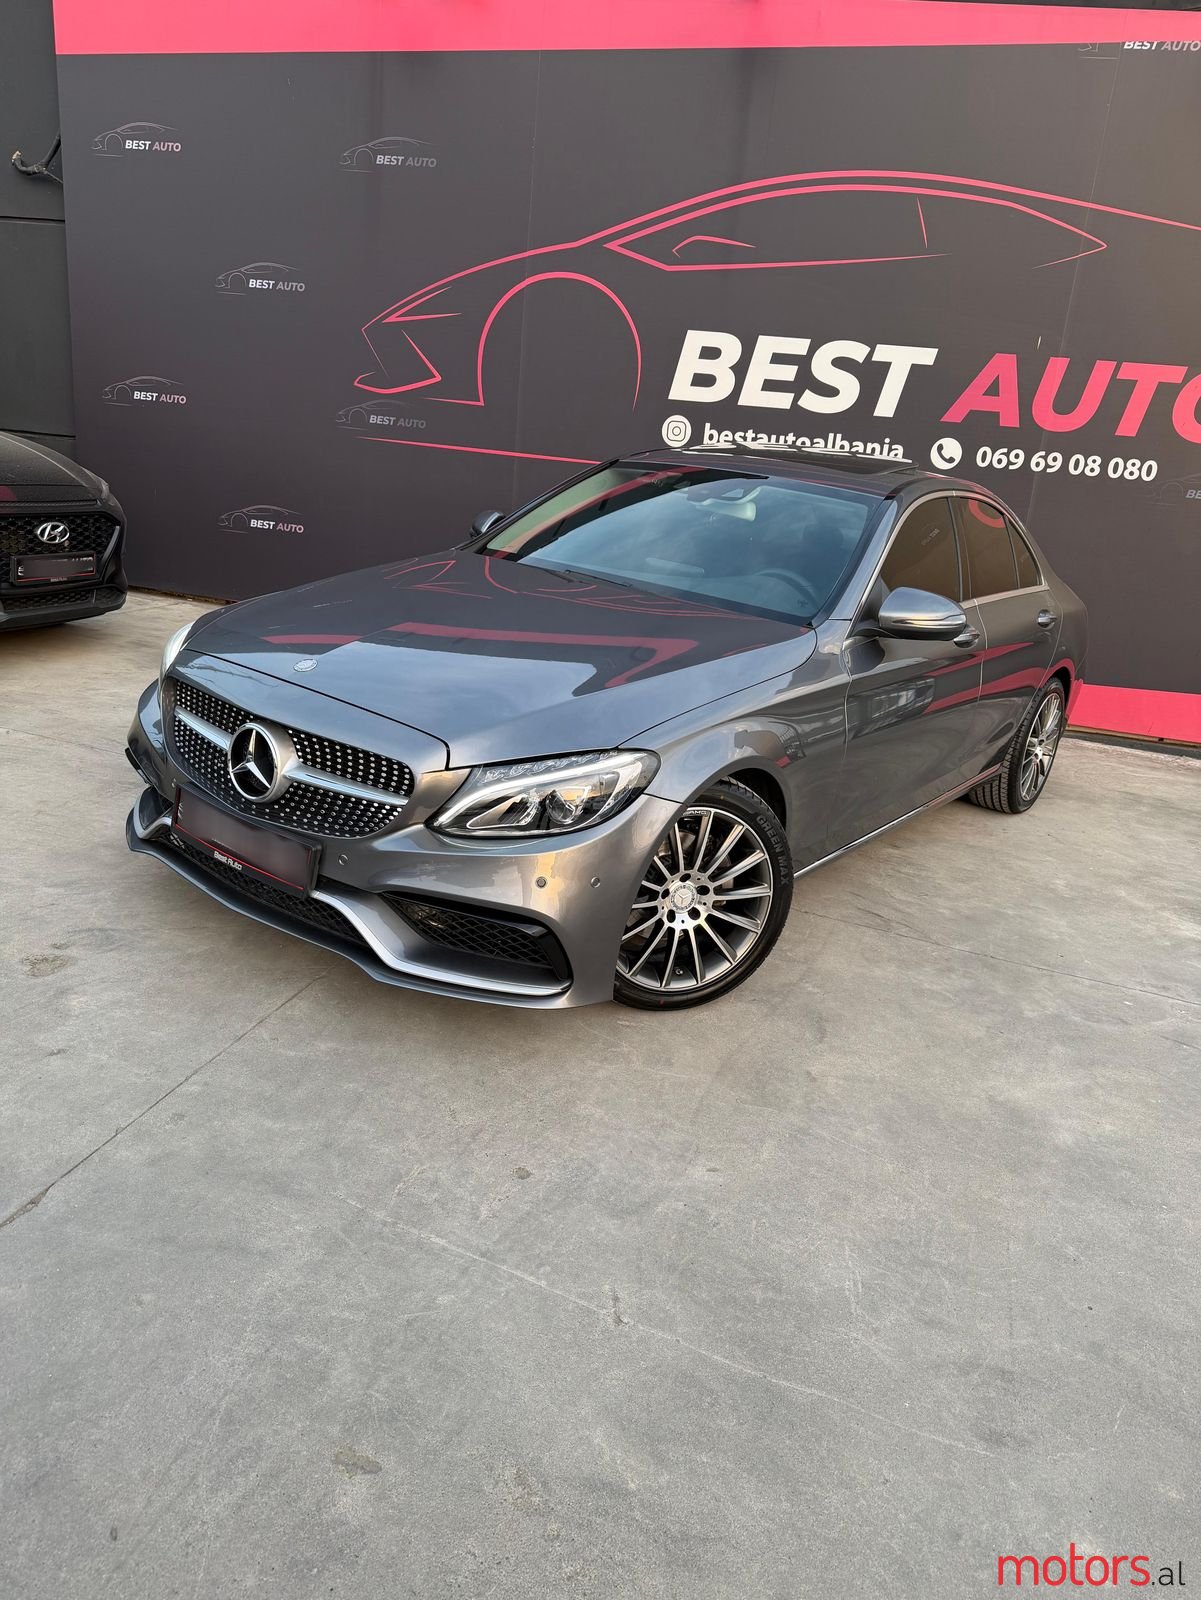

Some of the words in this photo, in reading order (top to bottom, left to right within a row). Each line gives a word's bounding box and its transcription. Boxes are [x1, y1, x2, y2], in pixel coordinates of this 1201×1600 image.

[1123, 41, 1158, 50] BEST
[1161, 41, 1201, 51] AUTO
[125, 140, 151, 150] BEST
[152, 141, 182, 152] AUTO
[375, 155, 404, 166] BEST
[405, 157, 436, 168] AUTO
[249, 279, 275, 290] BEST
[276, 281, 305, 292] AUTO
[668, 329, 939, 418] BEST
[133, 390, 158, 401] BEST
[159, 393, 187, 404] AUTO
[369, 414, 396, 426] BEST
[397, 417, 426, 429] AUTO
[975, 446, 1025, 470] 069
[1030, 450, 1063, 473] 69
[1068, 453, 1102, 477] 08
[1107, 457, 1158, 482] 080
[250, 519, 275, 530] BEST
[276, 522, 304, 533] AUTO
[757, 816, 783, 852] GREEN
[778, 855, 789, 885] MAX
[214, 851, 227, 863] Best
[228, 859, 242, 870] Auto
